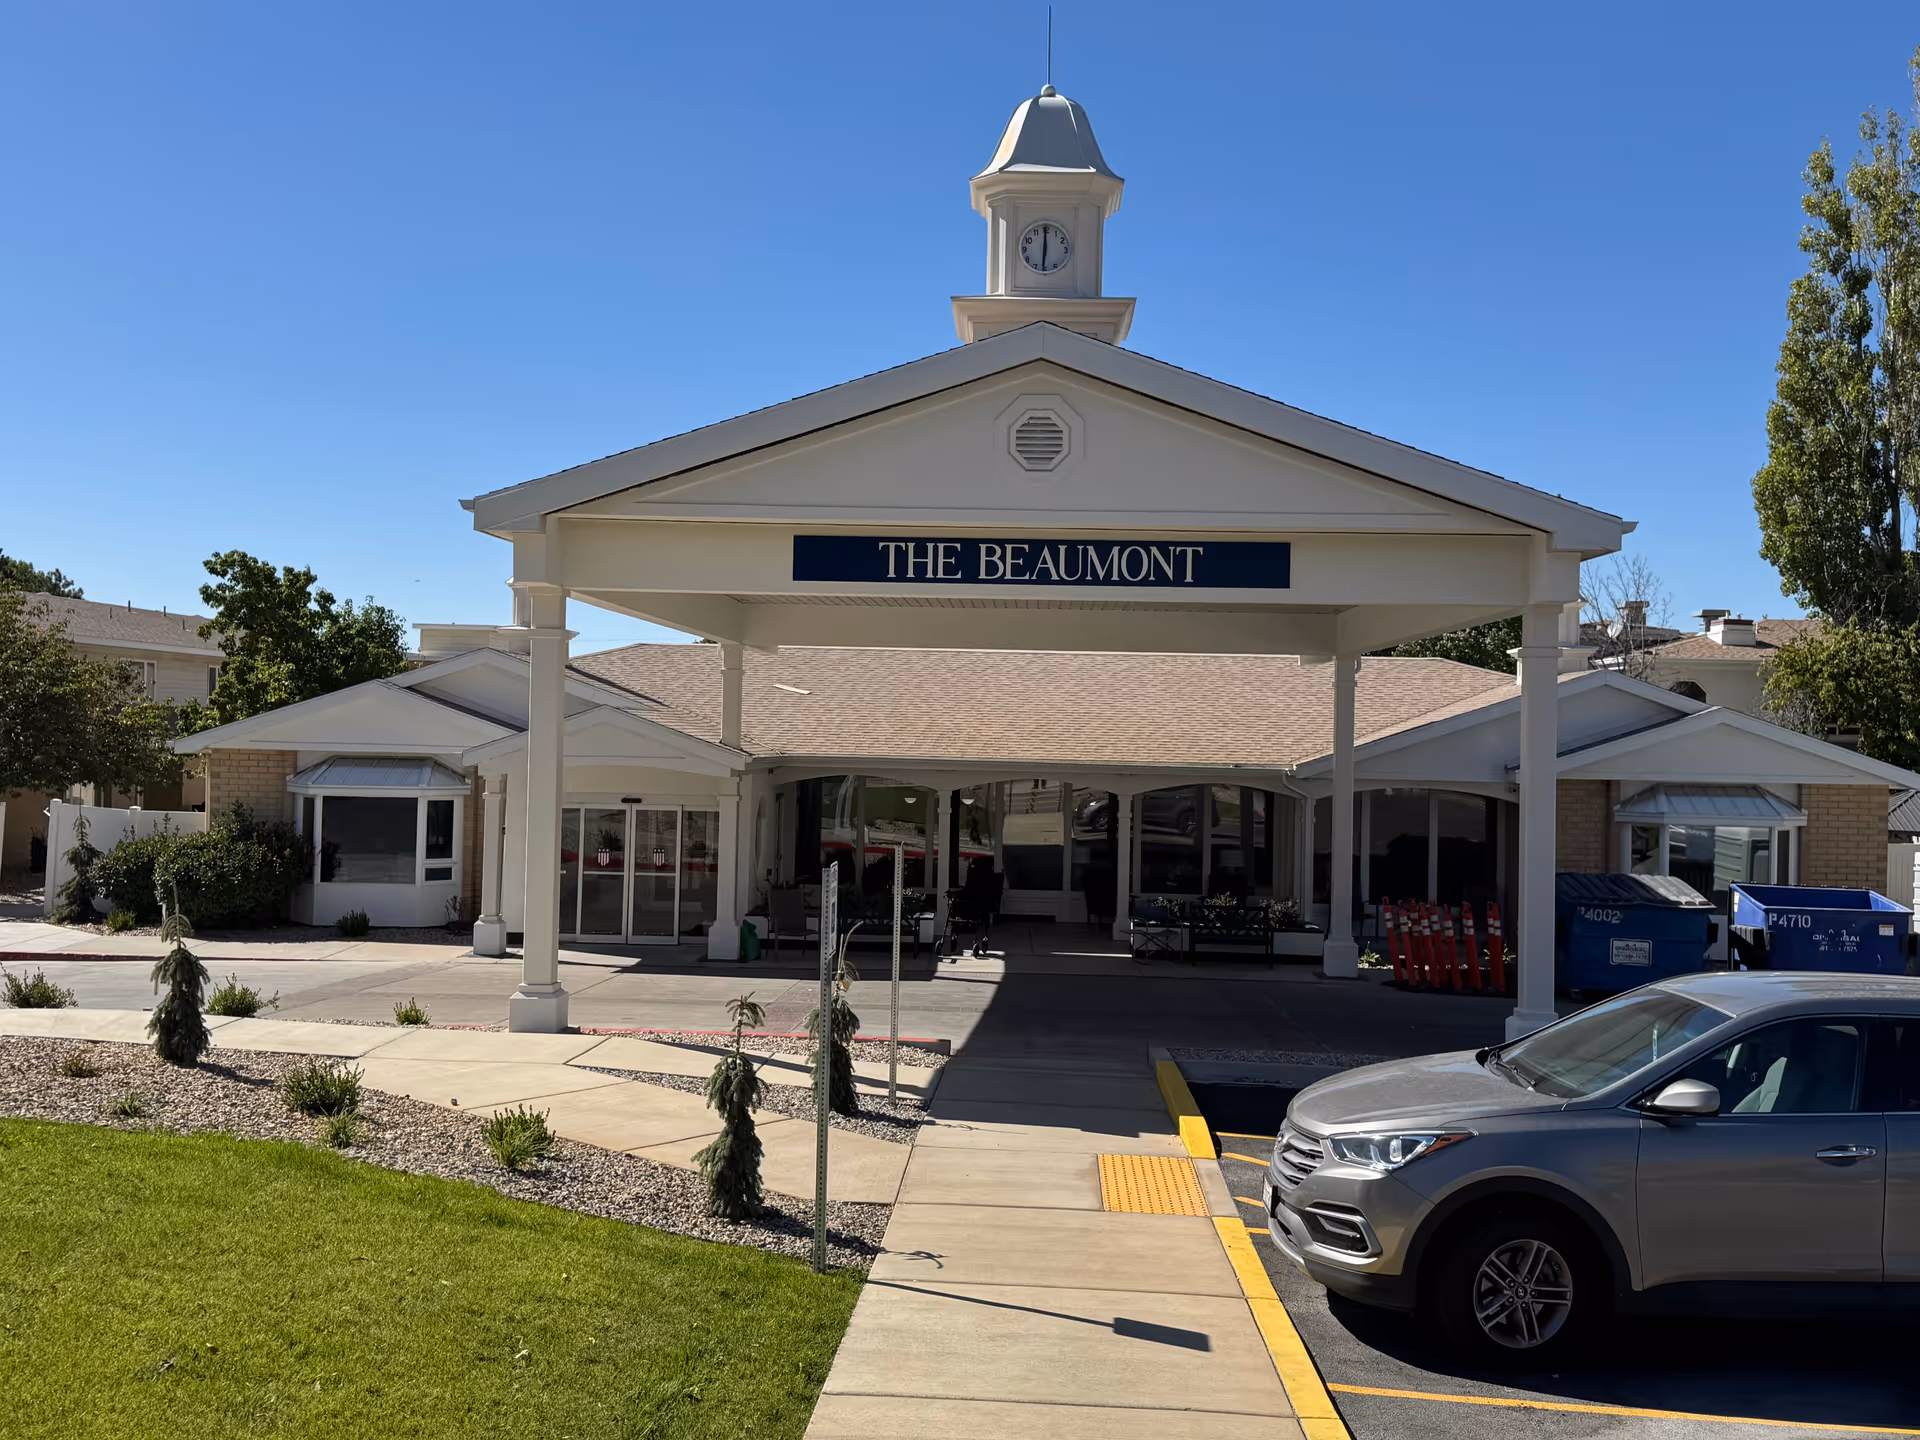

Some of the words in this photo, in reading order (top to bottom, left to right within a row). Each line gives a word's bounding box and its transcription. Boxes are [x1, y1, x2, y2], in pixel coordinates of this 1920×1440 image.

[878, 541, 962, 579] THE
[978, 543, 1204, 583] BEAUMONT
[1768, 912, 1811, 928] P4710
